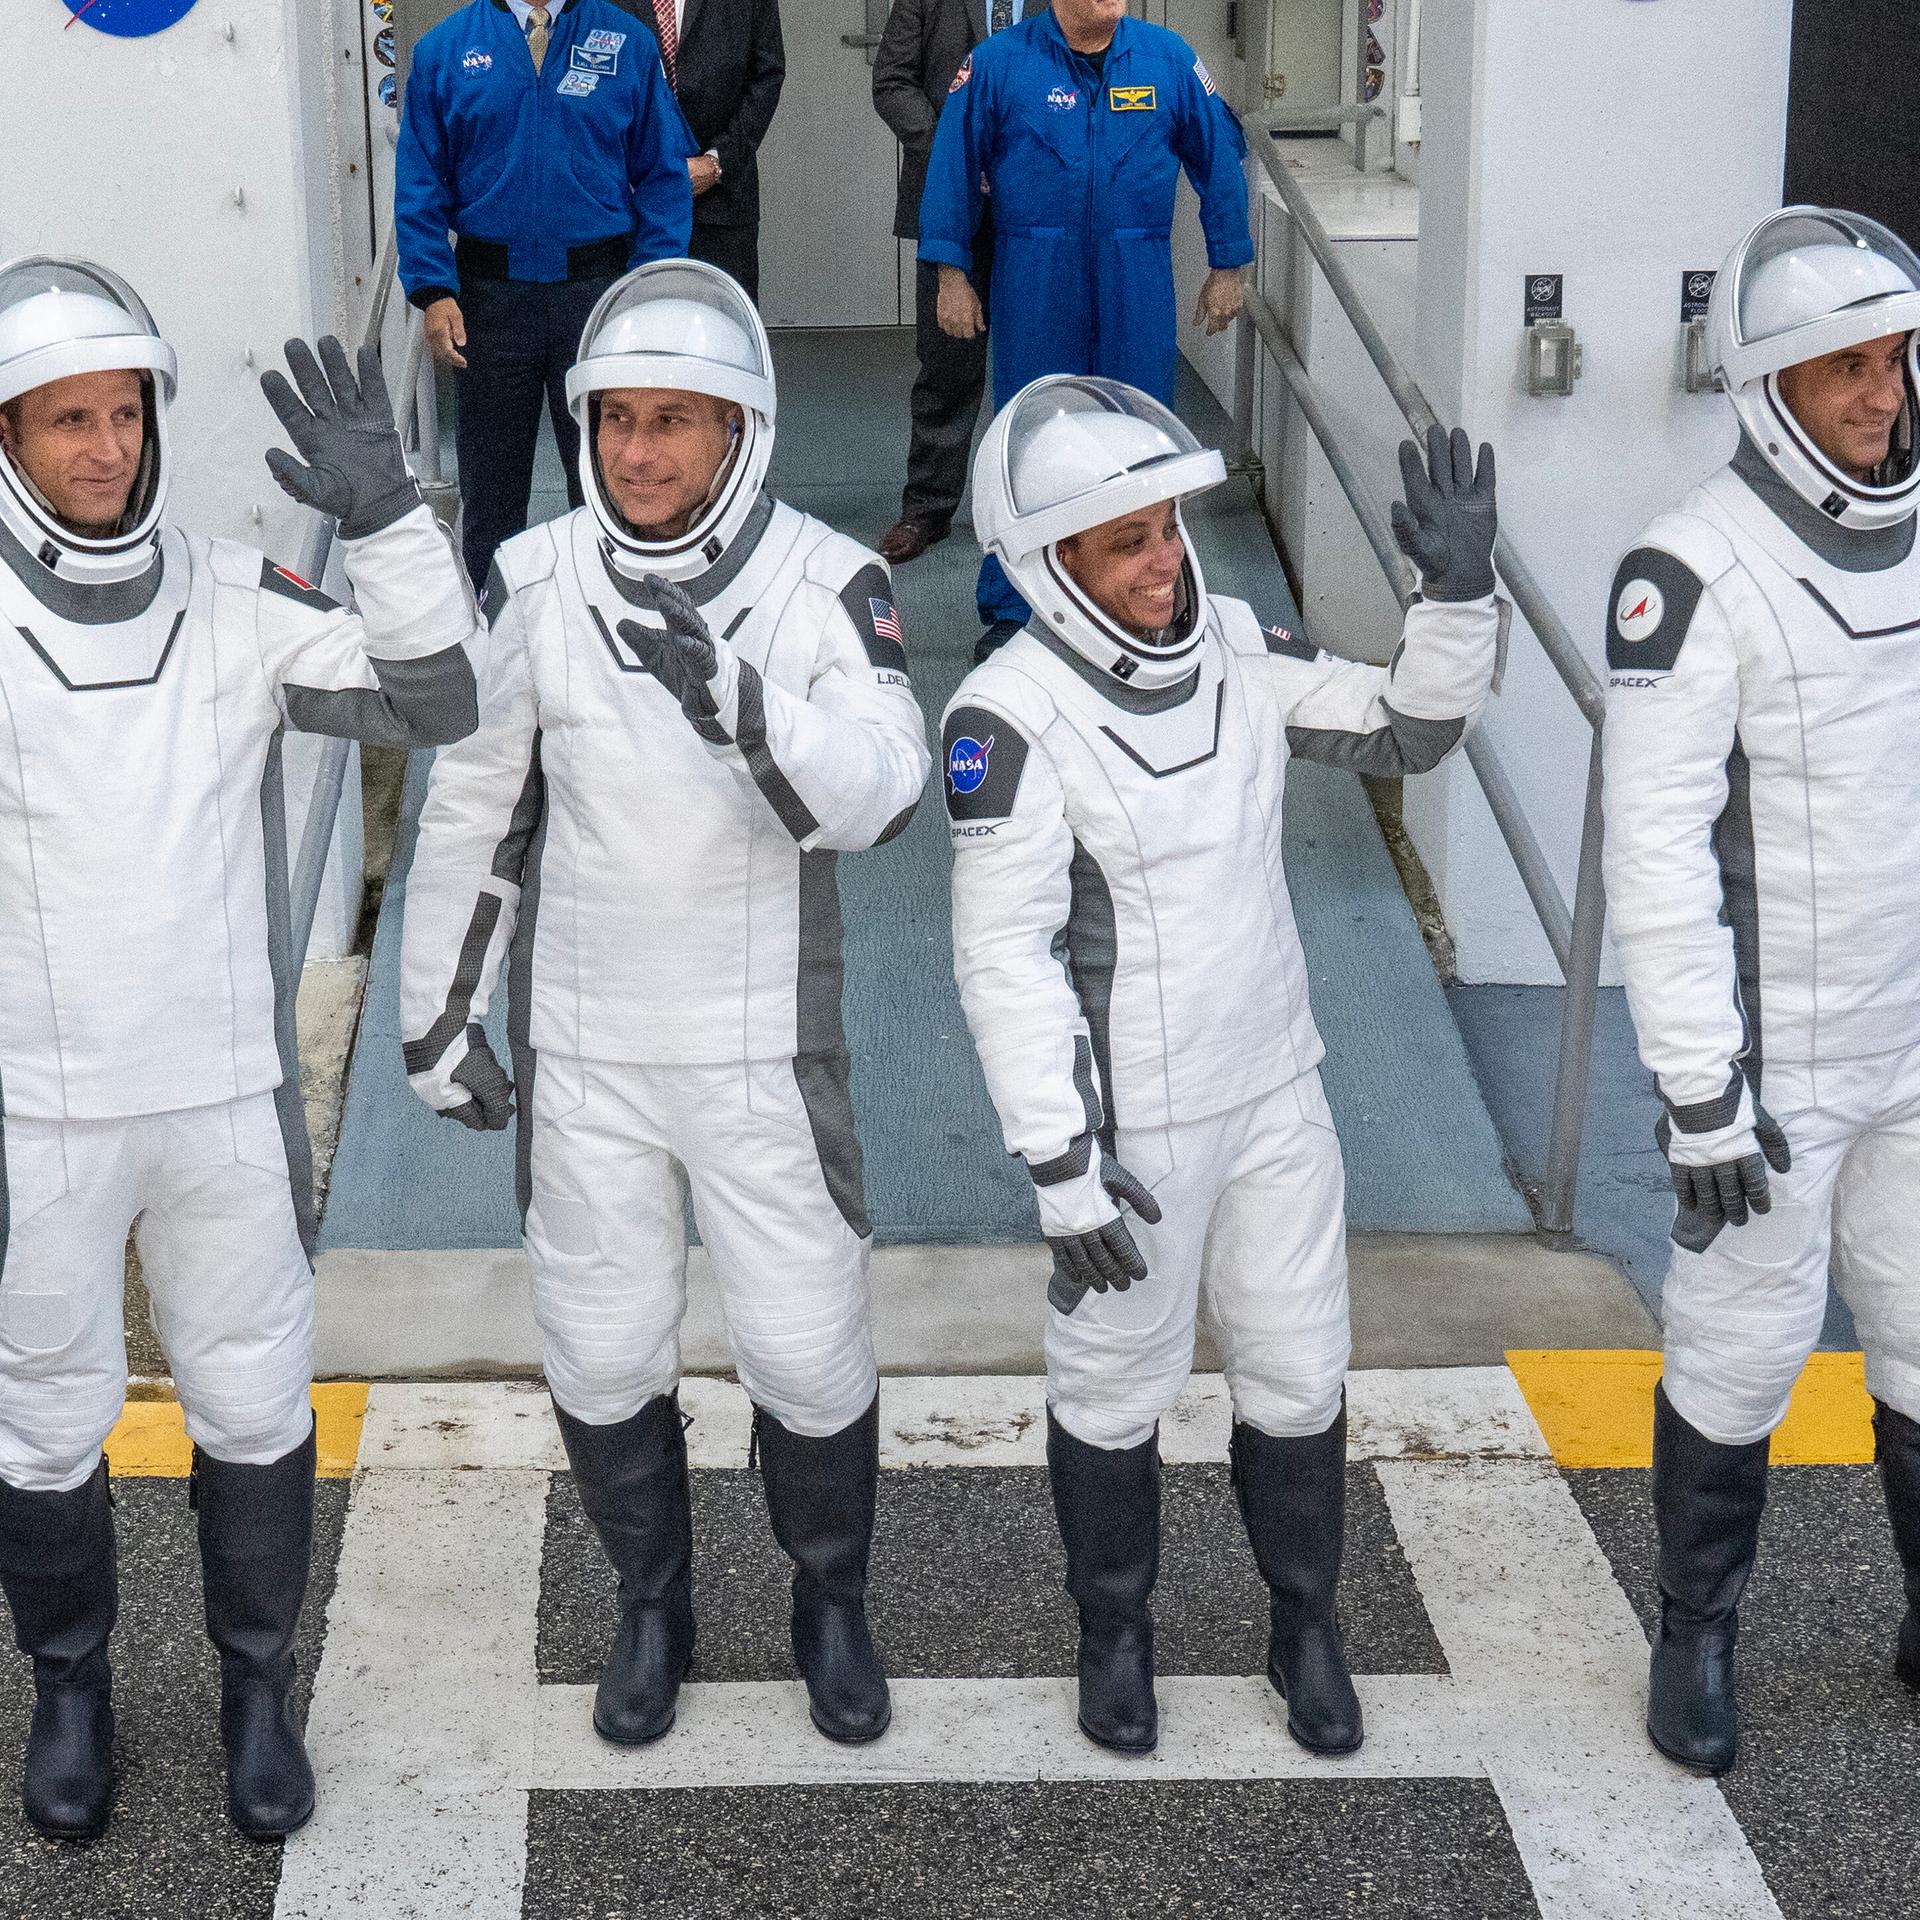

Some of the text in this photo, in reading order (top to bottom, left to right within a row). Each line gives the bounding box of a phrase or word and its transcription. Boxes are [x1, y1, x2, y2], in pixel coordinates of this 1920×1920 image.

[462, 54, 492, 68] NASA
[1047, 94, 1077, 104] NASA
[1609, 674, 1676, 688] SPACEX
[952, 759, 983, 771] NASA
[951, 820, 1013, 838] SPACEX
